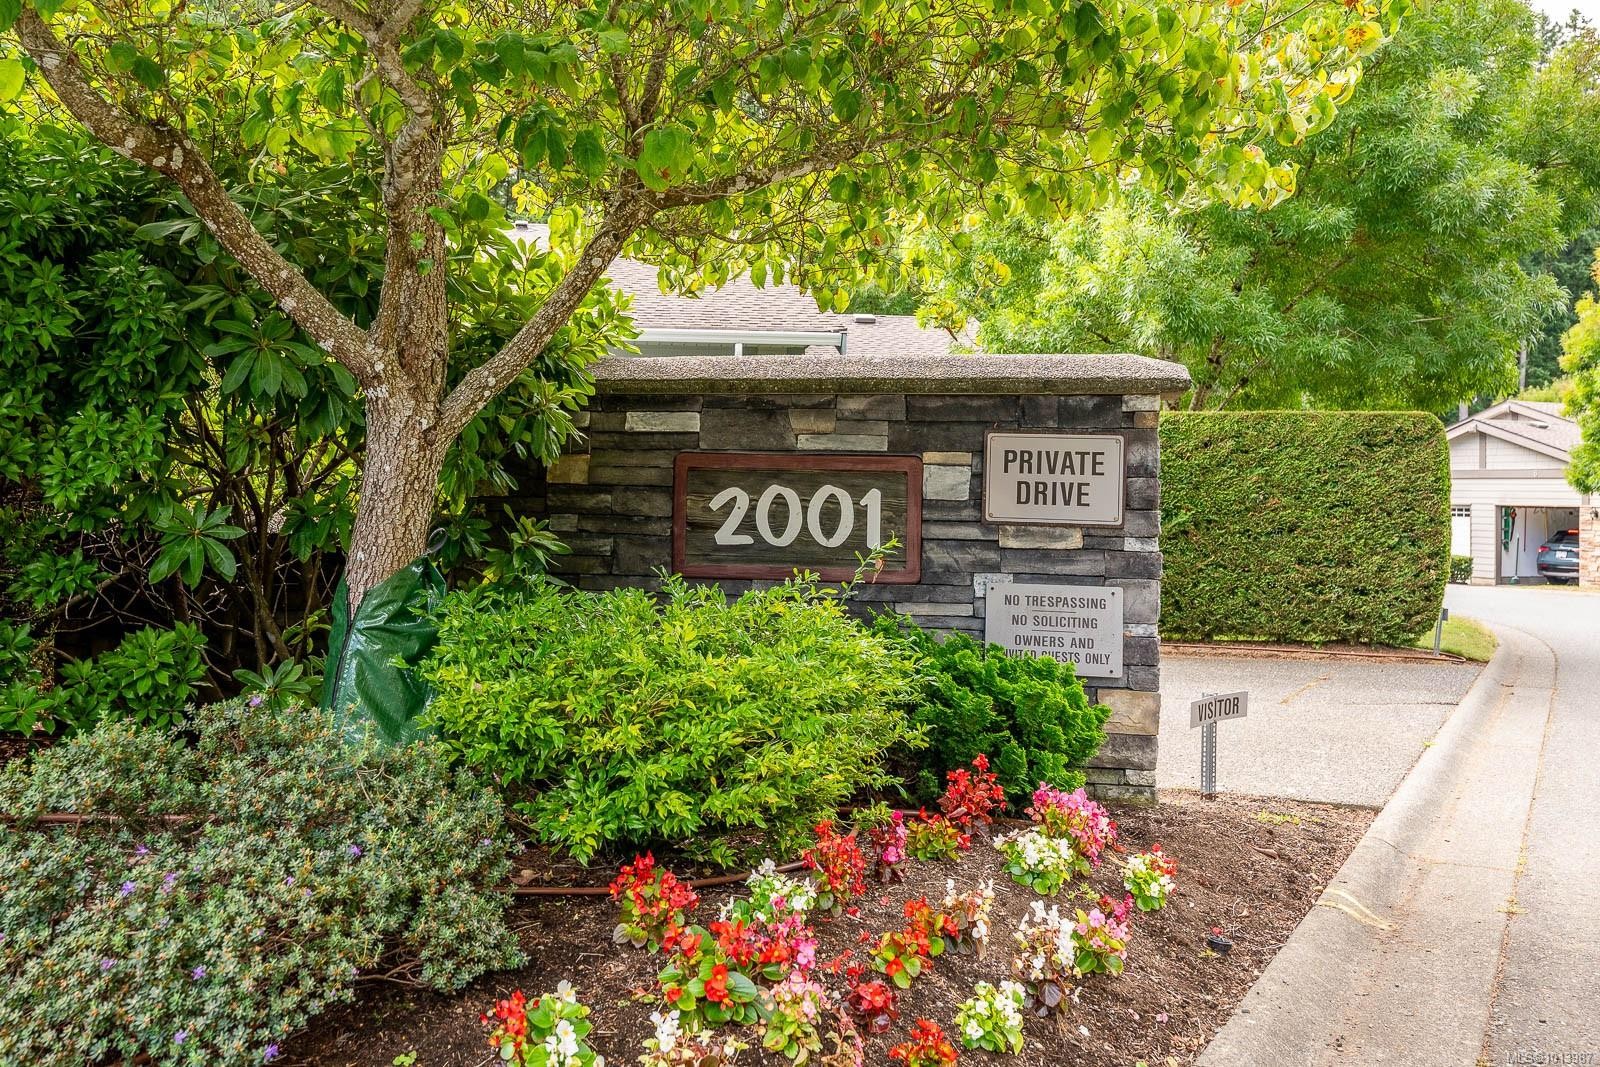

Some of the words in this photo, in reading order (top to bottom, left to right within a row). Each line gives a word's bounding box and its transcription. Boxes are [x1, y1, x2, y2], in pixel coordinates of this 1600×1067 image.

[1003, 449, 1105, 476] PRIVATE
[1016, 480, 1091, 507] DRIVE
[708, 484, 882, 549] 2001
[1004, 594, 1020, 606] NO
[1025, 595, 1107, 610] TRESPASSING
[1011, 614, 1027, 626] NO
[1033, 615, 1098, 629] SOLICITING
[1014, 634, 1065, 648] OWNERS
[1070, 637, 1095, 650] AND
[1003, 648, 1037, 660] NVITD
[1085, 652, 1111, 665] ONLY
[1198, 696, 1240, 722] VISITOR
